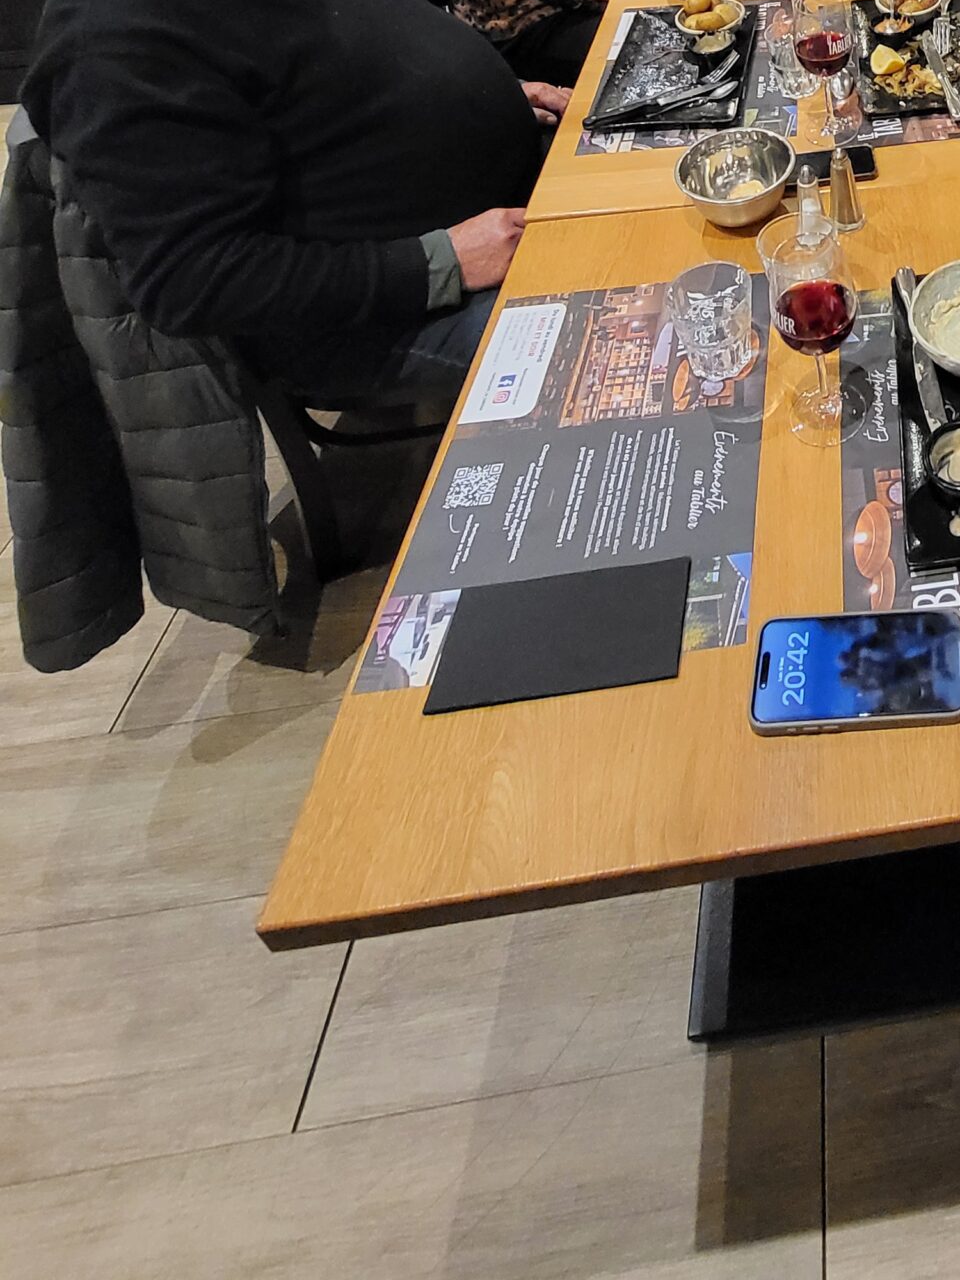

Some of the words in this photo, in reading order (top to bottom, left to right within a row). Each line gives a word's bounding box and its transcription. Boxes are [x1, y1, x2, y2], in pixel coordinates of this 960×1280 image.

[693, 469, 703, 486] au
[687, 486, 704, 529] Tablier
[782, 631, 809, 706] 20:42
